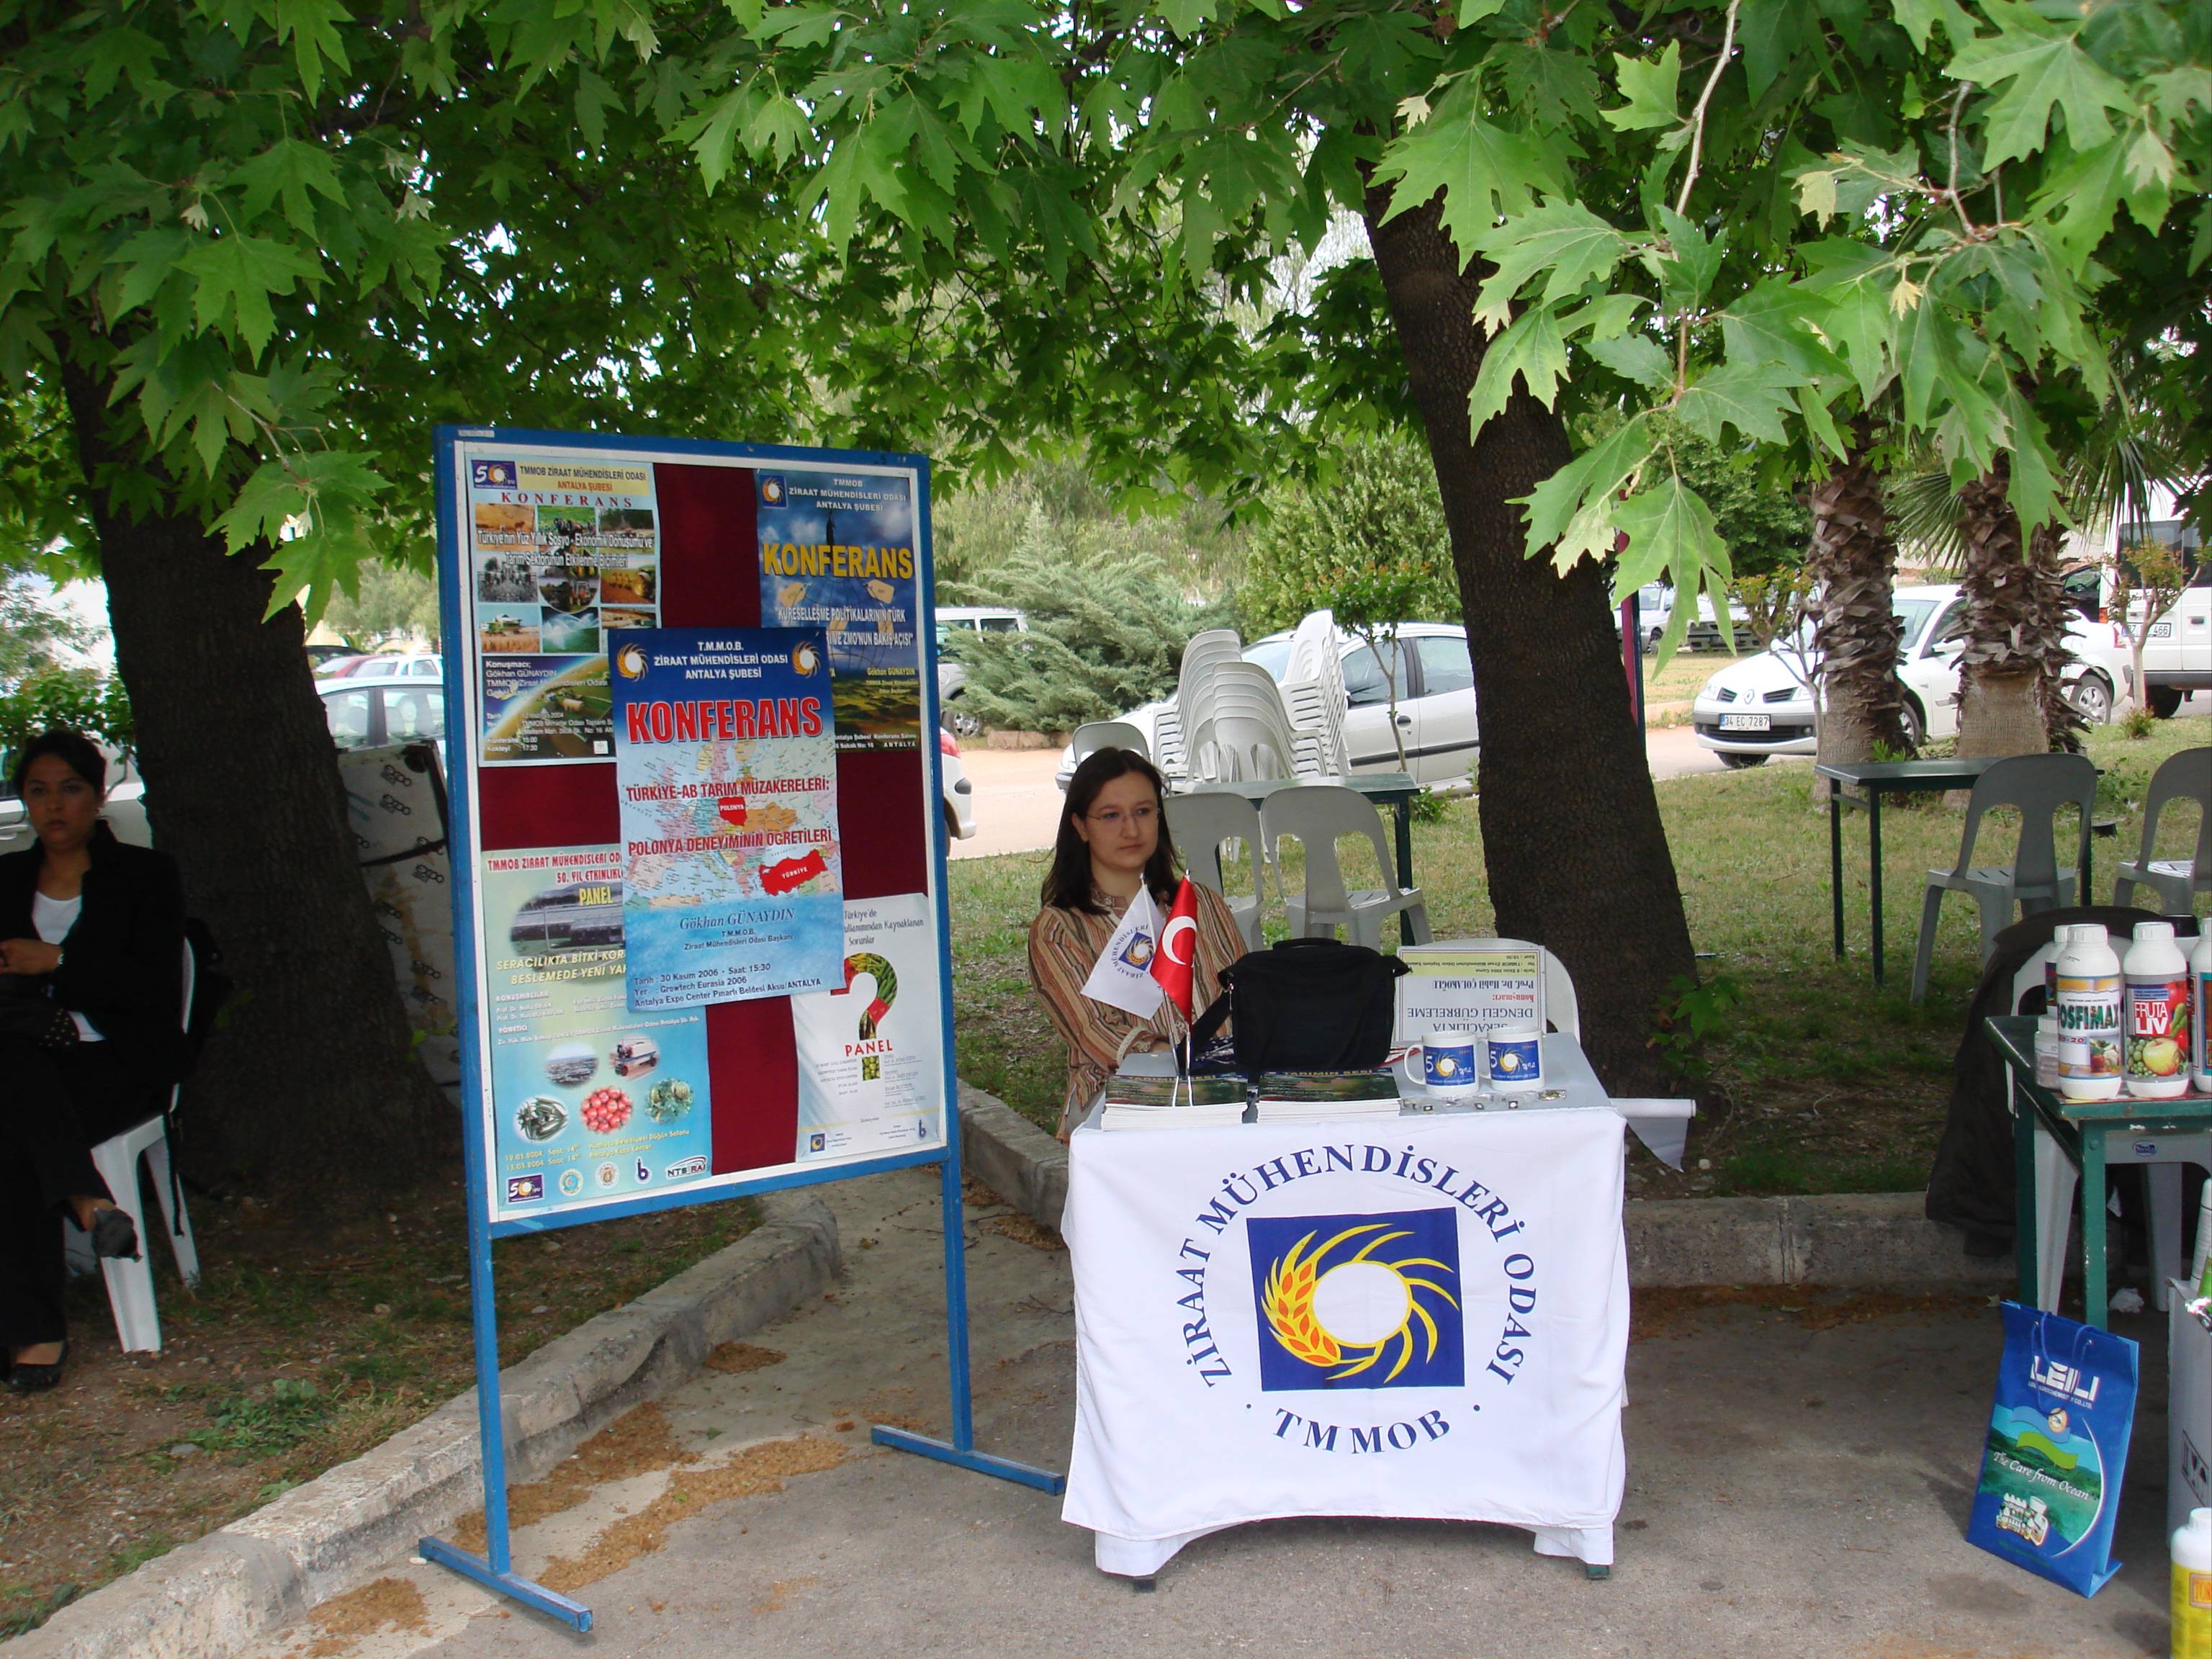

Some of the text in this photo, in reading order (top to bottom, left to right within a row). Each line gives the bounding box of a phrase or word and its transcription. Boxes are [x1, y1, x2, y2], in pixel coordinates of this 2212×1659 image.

[520, 466, 646, 480] TMMOB ZİRAAT MÜHENDİSLERİ ODASI
[557, 480, 613, 493] ANTALYA ŞUBESİ
[789, 487, 818, 496] ZİRAAT
[820, 488, 881, 500] MÜHENDİSLERİ
[816, 501, 852, 510] ANTALYA
[548, 533, 570, 548] Sosyo
[575, 534, 607, 547] Ekonomik
[644, 538, 653, 548] ve
[505, 552, 525, 565] Tarım
[566, 554, 598, 567] Etkilenme
[763, 542, 914, 579] KONFERANS
[889, 606, 906, 622] TÜRK
[2154, 625, 2168, 634] 466
[698, 642, 744, 651] T.M.M.O.B.
[874, 633, 893, 648] BAKIŞ
[654, 653, 788, 666] ZİRAAT MÜHENDİSLERİ ODASI
[518, 669, 557, 678] GÜNAYDIN
[685, 668, 762, 681] ANTALYA ŞUBESİ
[626, 696, 822, 744] KONFERANS
[1725, 716, 1768, 727] 34 EC 7287
[626, 783, 697, 801] TÜRKİYE-AB
[700, 781, 737, 798] TARIM
[628, 837, 683, 857] POLONYA
[686, 832, 763, 853] DENEYİMİNİN
[487, 860, 519, 871] TMMOB
[522, 855, 549, 869] ZİRAAT
[552, 852, 606, 866] MÜHENDİSLERİ
[557, 872, 569, 883] 50.
[572, 871, 583, 881] YIL
[782, 866, 808, 879] TÜRKİYE
[578, 886, 613, 906] PANEL
[680, 908, 795, 930] Gökhan GÜNAYDIN
[884, 919, 924, 932] Kaynaklanan
[684, 933, 794, 950] Ziraat Mühendisleri Odası Başkanı
[849, 935, 875, 945] Sorunlar
[496, 956, 567, 971] SERACILIKTA
[511, 969, 577, 984] BESLEMEDE
[634, 976, 654, 986] Tarih
[660, 974, 671, 982] 30
[673, 971, 696, 981] Kasım
[698, 968, 719, 979] 2006
[749, 963, 771, 973] 15:30
[634, 976, 747, 996] Yer Growtech Eurasia 2006
[1479, 980, 1499, 989] Habil
[1501, 981, 1513, 989] Dr.
[1515, 980, 1534, 989] Prof.
[634, 996, 664, 1009] Antalya
[666, 994, 684, 1006] Expo
[685, 992, 711, 1002] Center
[712, 989, 738, 998] Pınarlı
[739, 985, 765, 995] Beldesi
[767, 978, 822, 992] Aksu/ANTALYA
[1492, 993, 1534, 1003] Konuşmacı:
[1408, 1008, 1533, 1021] DENGELİ GÜBRELEME
[2134, 1002, 2169, 1017] FRUTA
[2135, 1017, 2169, 1035] LIV
[845, 1039, 893, 1057] PANEL
[667, 1167, 687, 1177] NTS
[1175, 1144, 1537, 1388] ZİRAAT MÜHENDİSLERİ ODASI
[1273, 1407, 1450, 1455] TMMOB
[1993, 1451, 2089, 1501] The Care from Ocean
